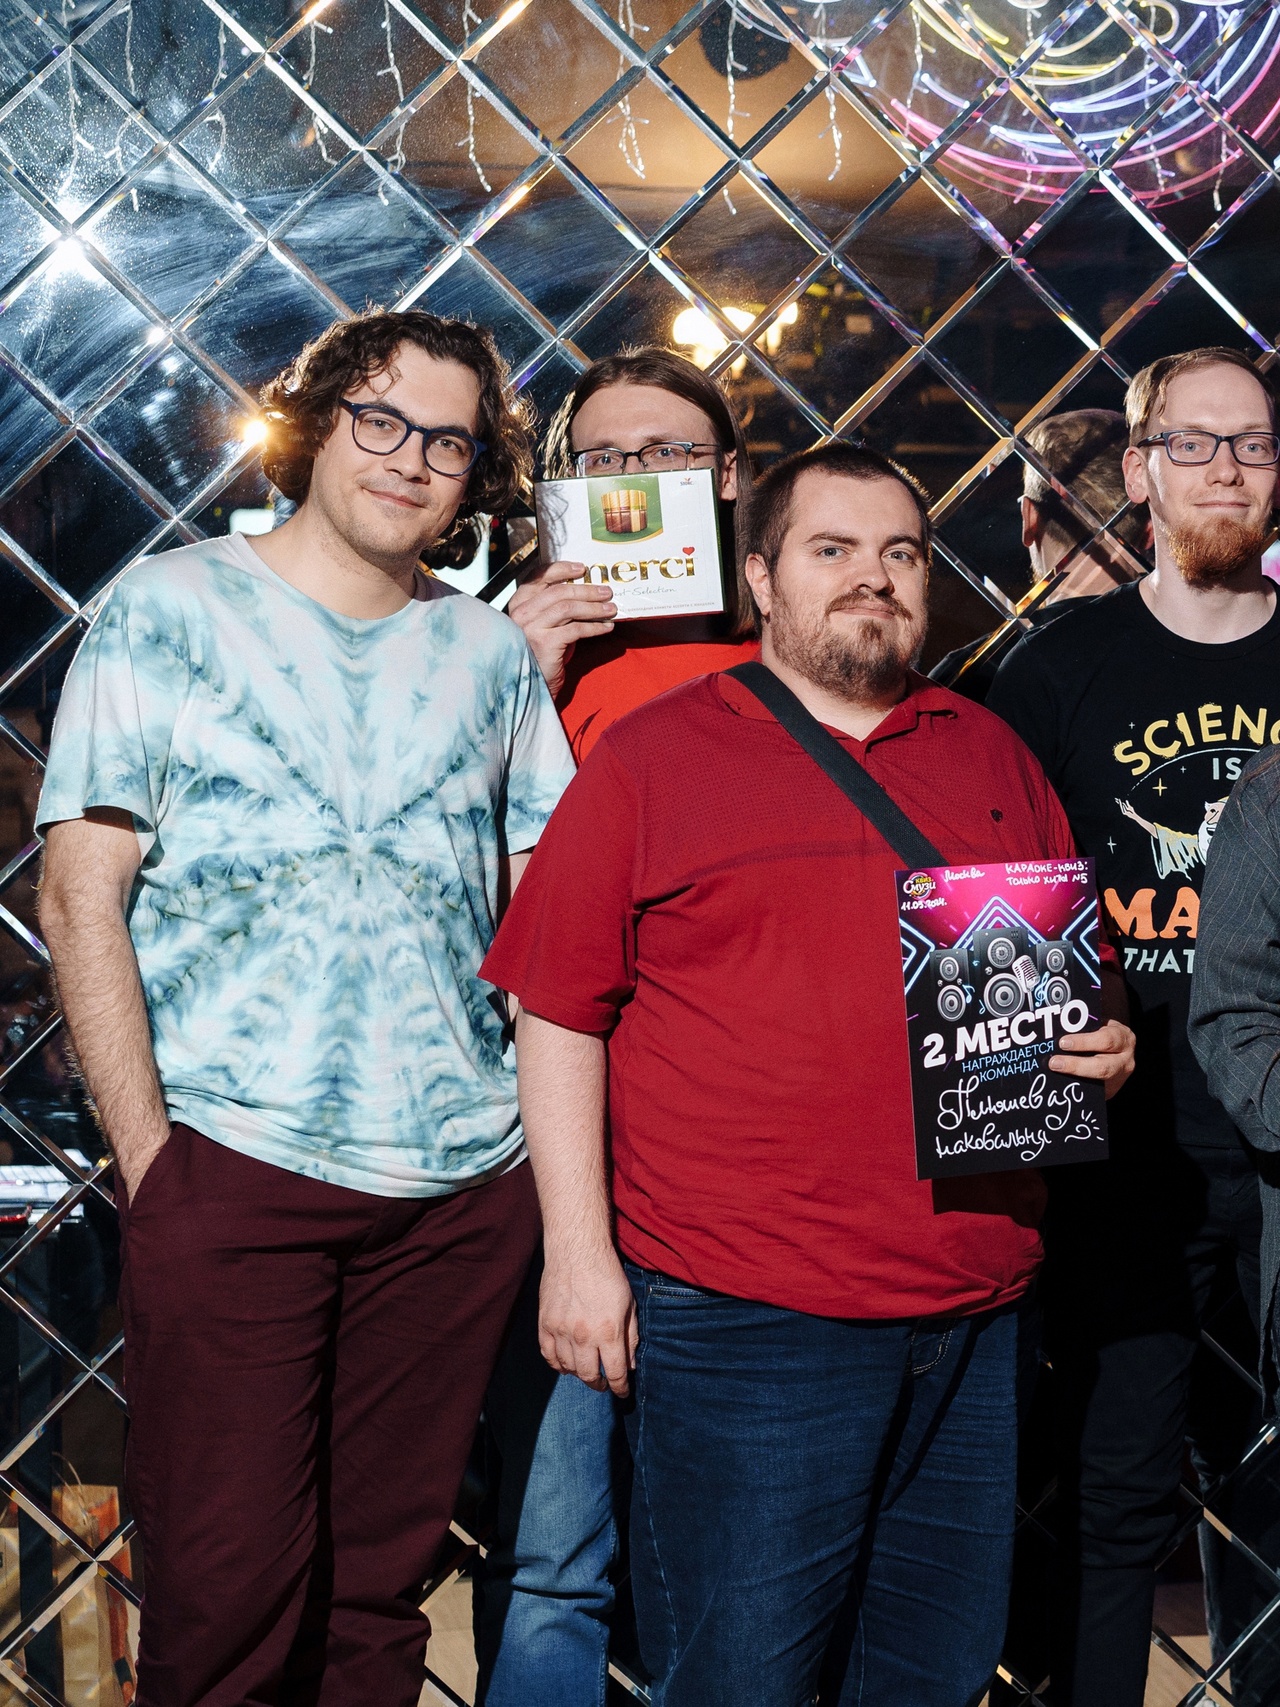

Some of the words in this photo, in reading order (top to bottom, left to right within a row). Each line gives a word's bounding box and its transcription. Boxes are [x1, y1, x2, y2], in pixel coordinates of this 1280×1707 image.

[630, 585, 677, 596] Selection
[1212, 757, 1242, 780] IS
[902, 880, 936, 894] Смузи
[944, 867, 985, 883] Москва
[1103, 886, 1200, 940] MA
[1124, 947, 1196, 974] THAT
[923, 1032, 947, 1068] 2
[955, 999, 1089, 1062] МЕСТО
[961, 1040, 1055, 1073] НАГРАЖДАЕТСЯ
[979, 1058, 1039, 1082] КОМАНДА
[937, 1073, 1084, 1130] Плюшевая
